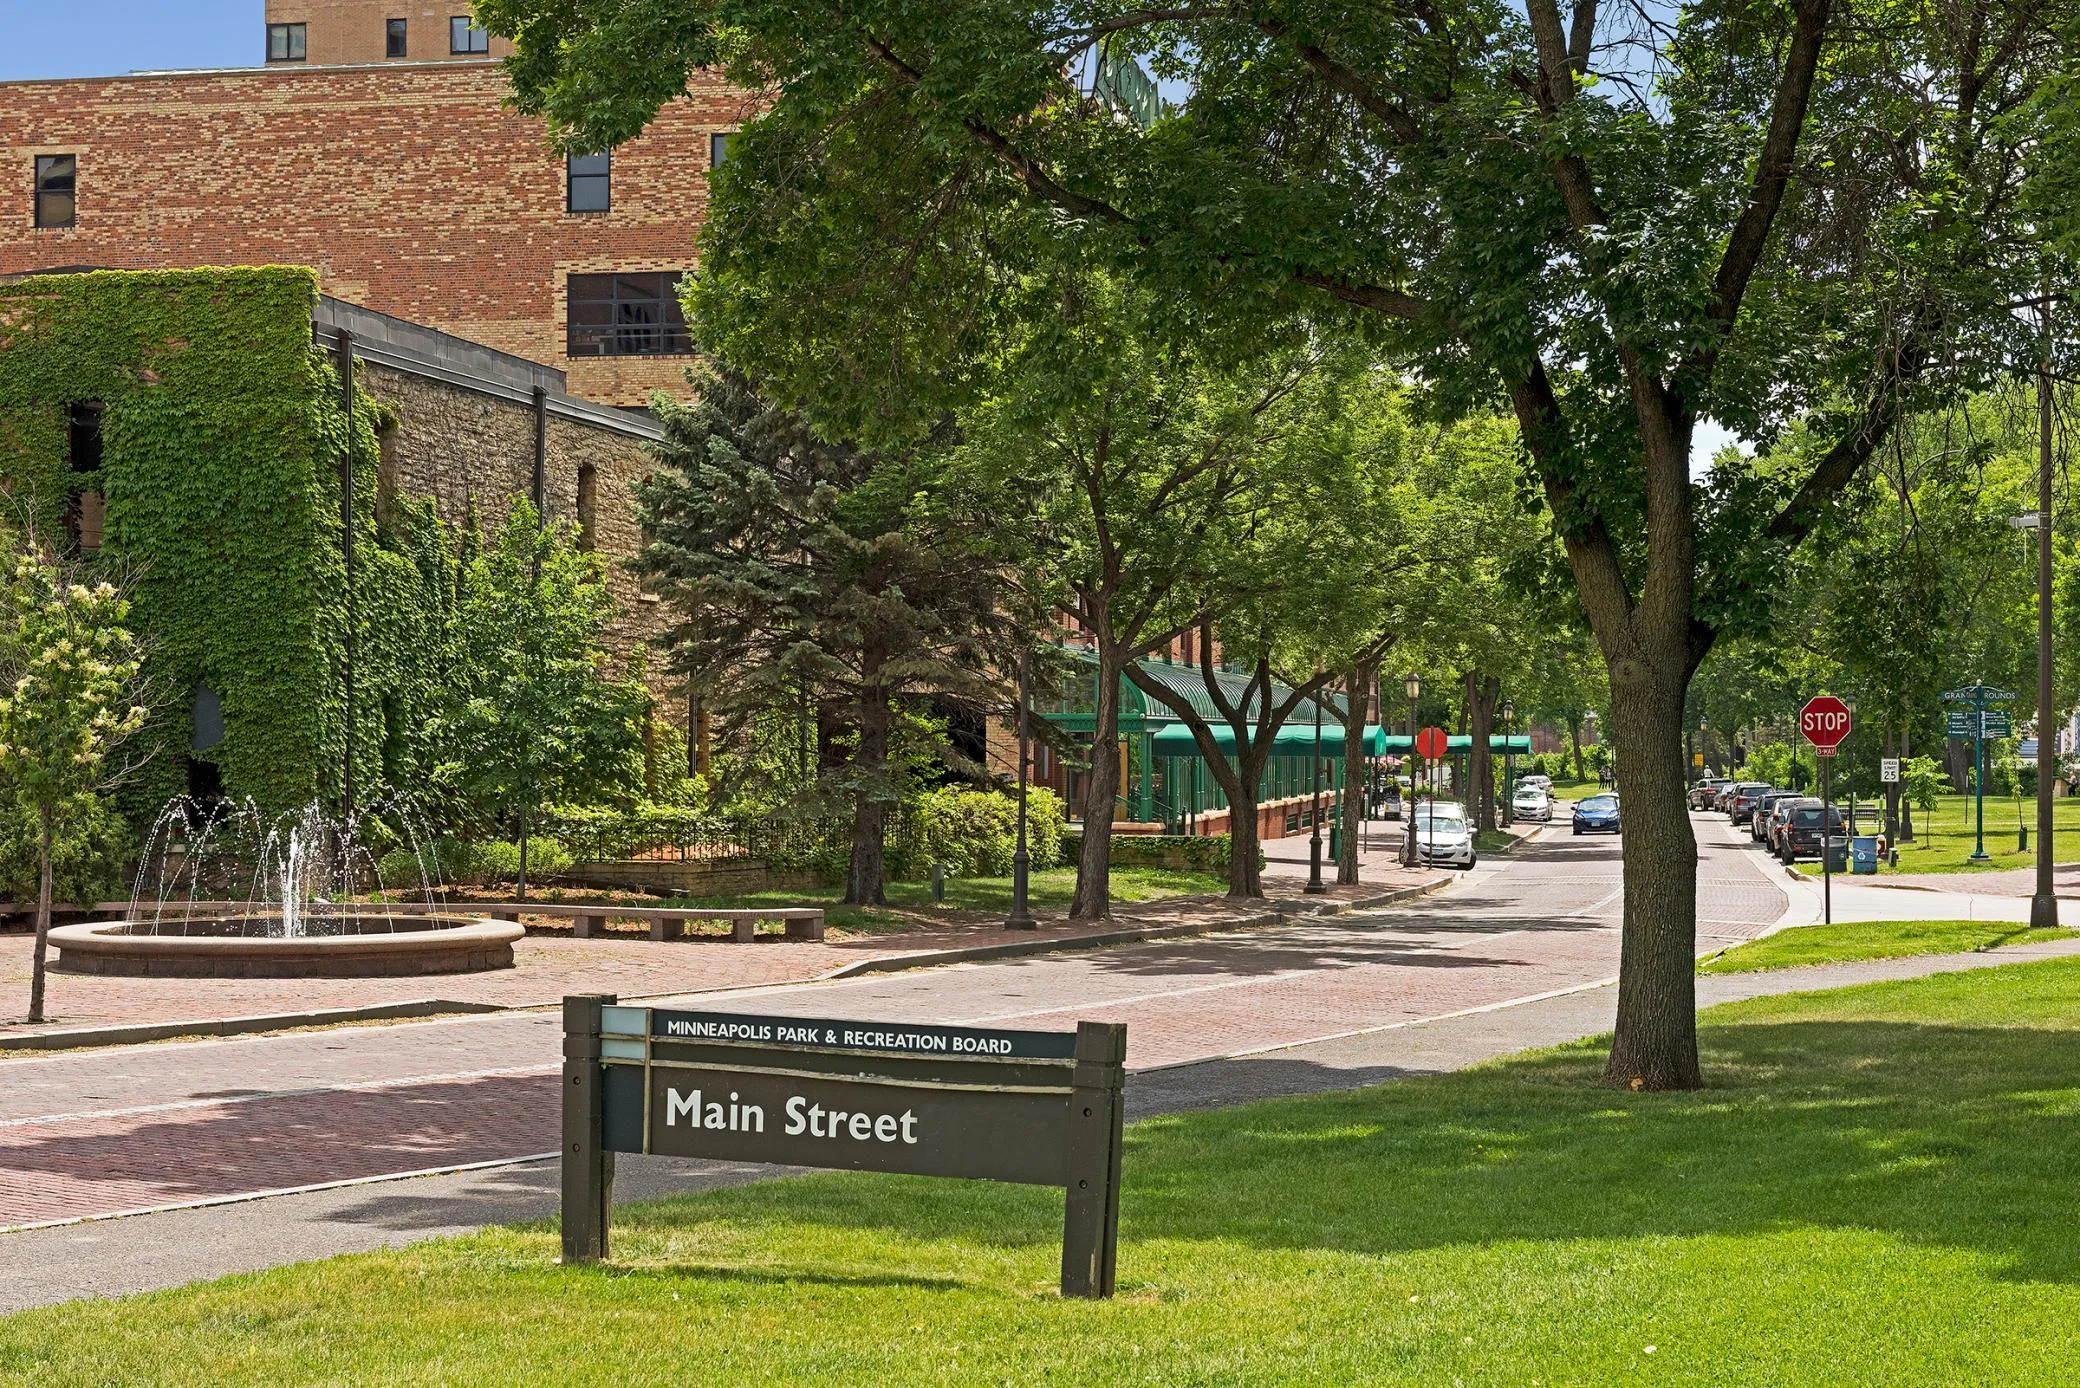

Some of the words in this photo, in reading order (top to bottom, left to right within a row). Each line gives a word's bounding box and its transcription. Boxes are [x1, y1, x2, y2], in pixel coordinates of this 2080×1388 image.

[1804, 712, 1847, 731] STOP
[1884, 770, 1896, 780] 25
[667, 1020, 771, 1040] MINNEAPOLIS
[777, 1026, 820, 1043] PARK
[825, 1029, 837, 1044] &
[844, 1030, 947, 1050] RECREATION
[952, 1036, 1012, 1054] BOARD
[666, 1087, 765, 1133] Main
[784, 1095, 919, 1144] Street
